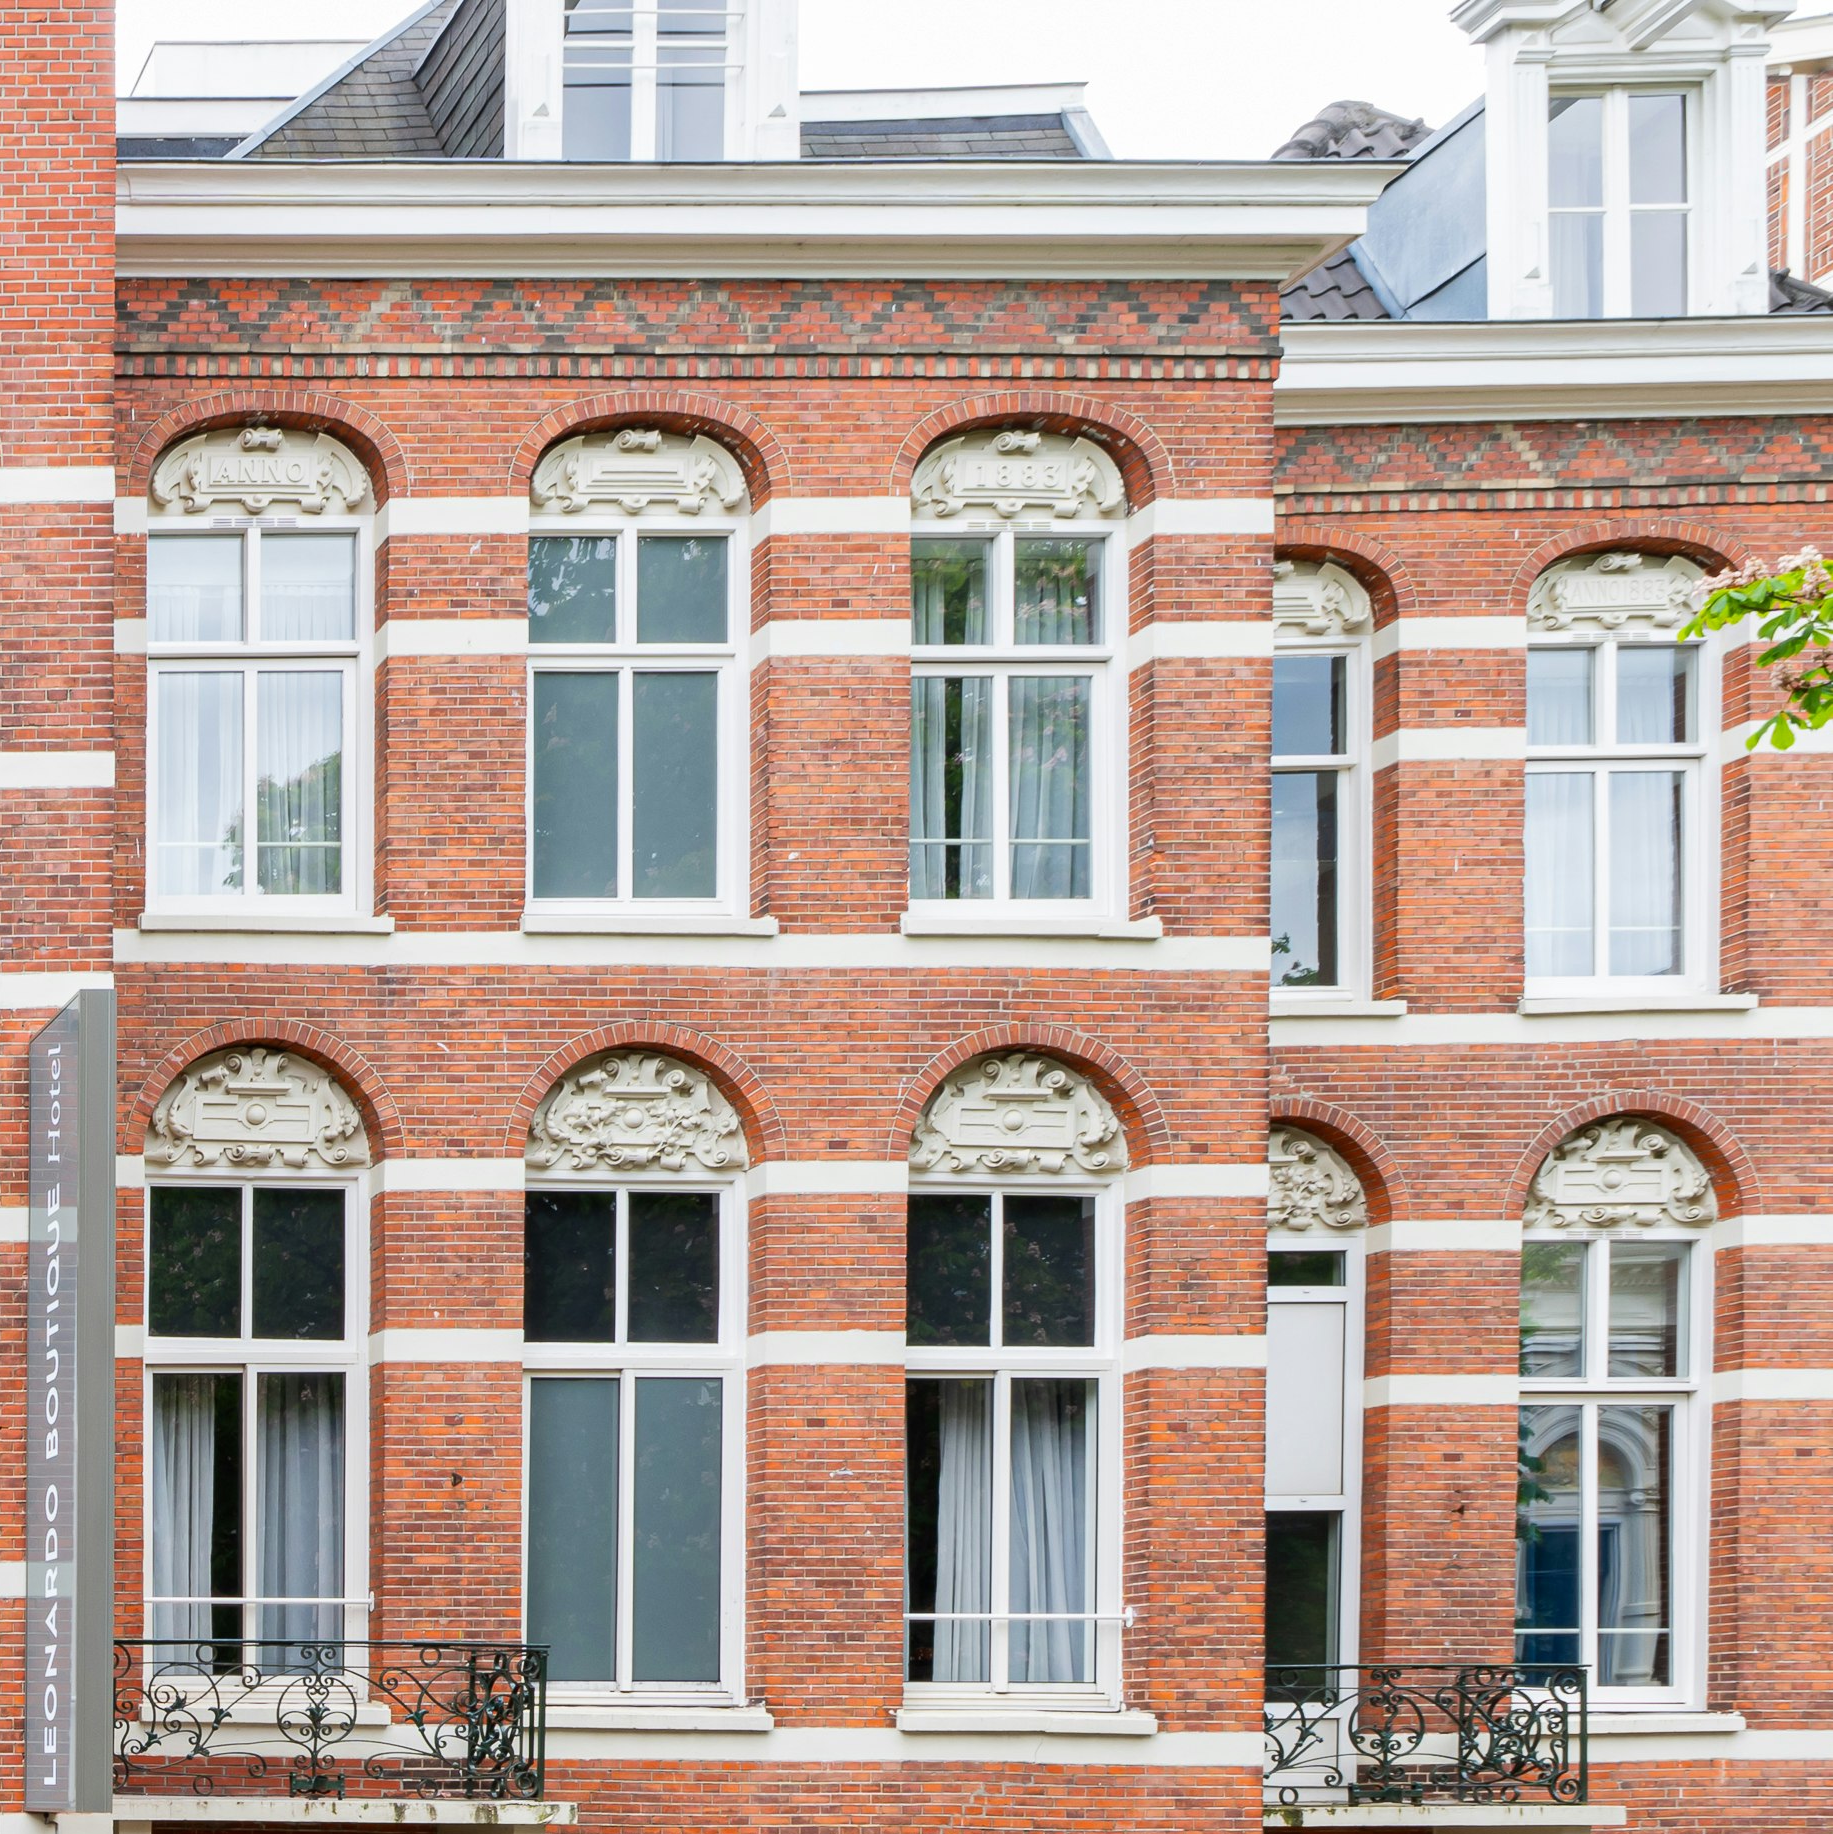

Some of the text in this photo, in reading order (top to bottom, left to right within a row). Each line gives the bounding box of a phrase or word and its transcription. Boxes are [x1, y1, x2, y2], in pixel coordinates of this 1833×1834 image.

[212, 458, 306, 483] ANNO
[976, 462, 1061, 489] 1883
[43, 1042, 62, 1787] LEONARDO BOUTIQUE Hotel
